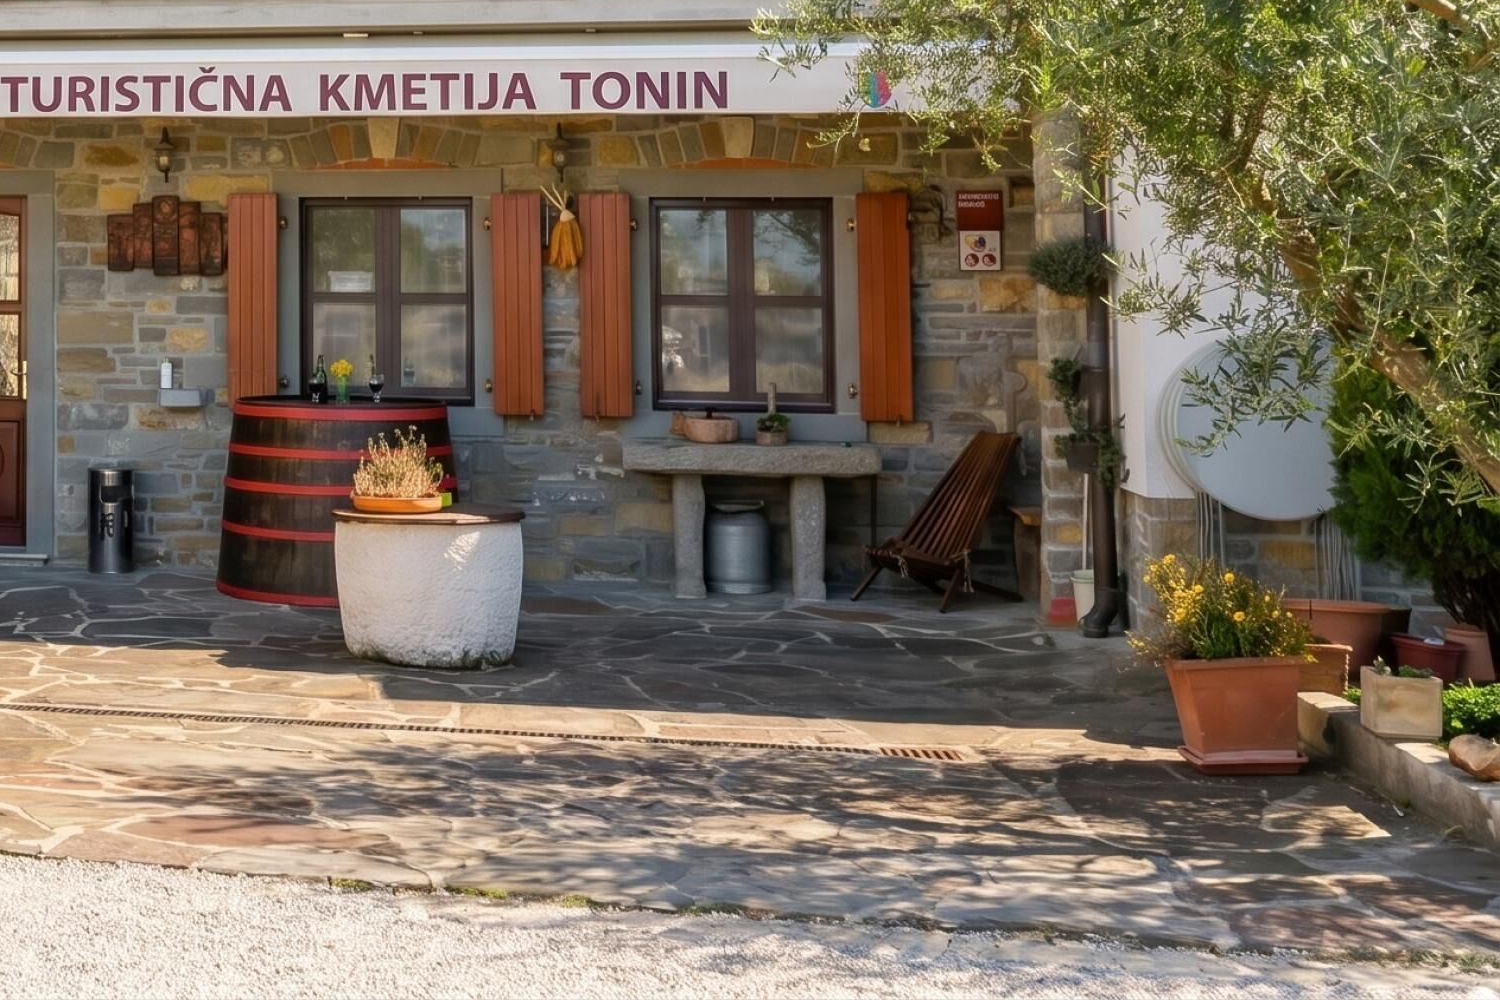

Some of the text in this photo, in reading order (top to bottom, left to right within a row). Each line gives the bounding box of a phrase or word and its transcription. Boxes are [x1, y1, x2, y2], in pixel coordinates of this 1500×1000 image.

[0, 66, 728, 113] TURISTIČNA KMETIJA TONIN
